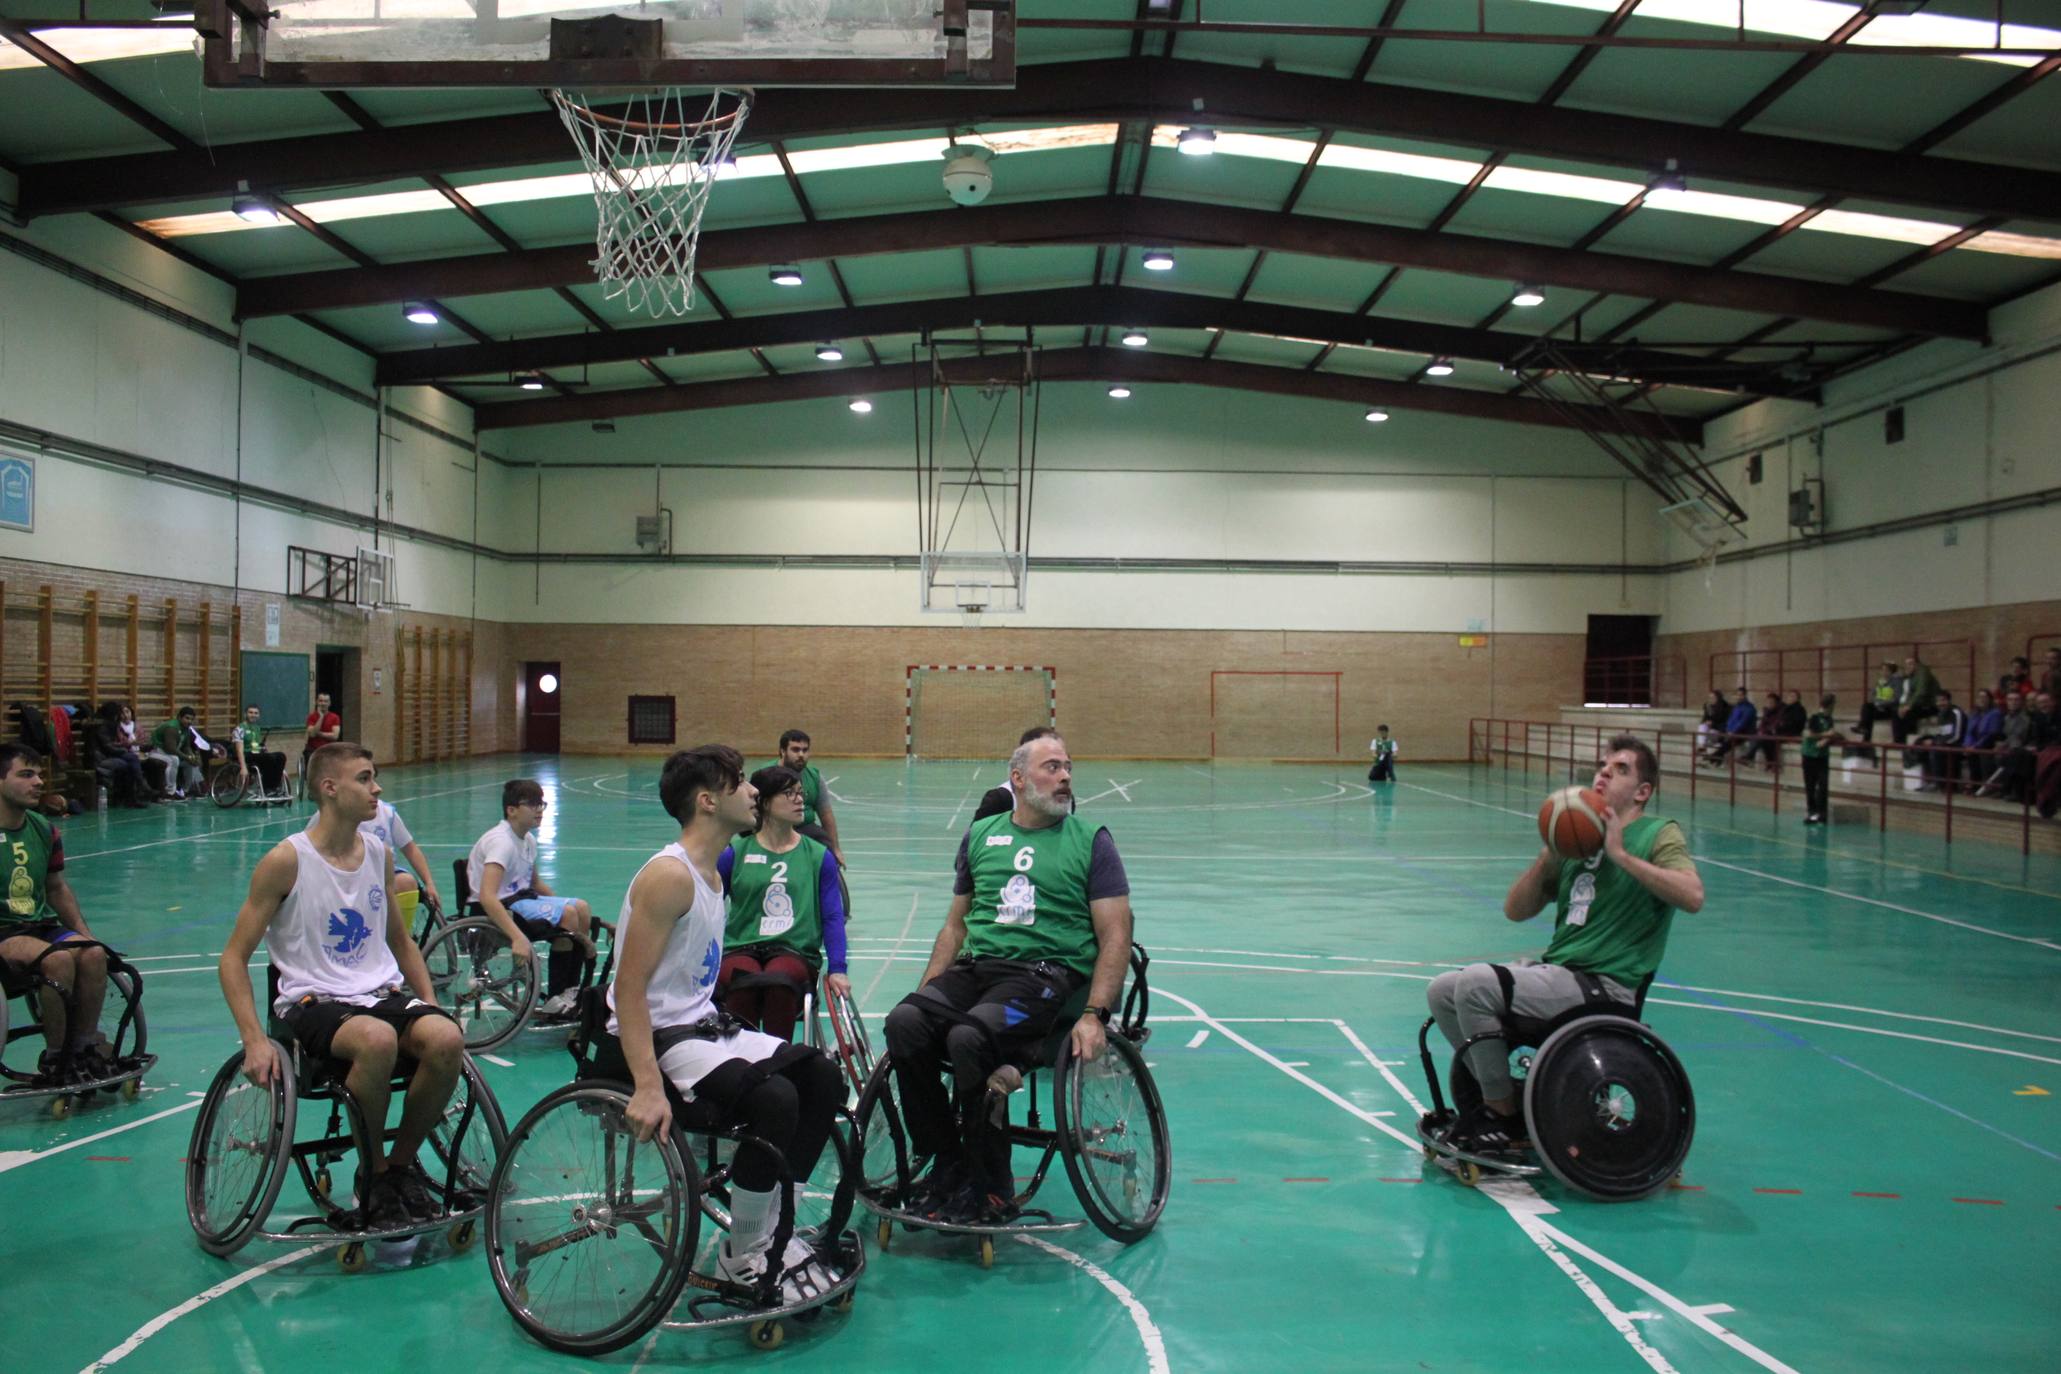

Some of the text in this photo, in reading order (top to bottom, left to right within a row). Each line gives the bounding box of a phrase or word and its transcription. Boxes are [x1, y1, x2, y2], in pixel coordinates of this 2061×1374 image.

[12, 841, 29, 865] 5
[1013, 846, 1035, 872] 6
[770, 861, 788, 883] 2
